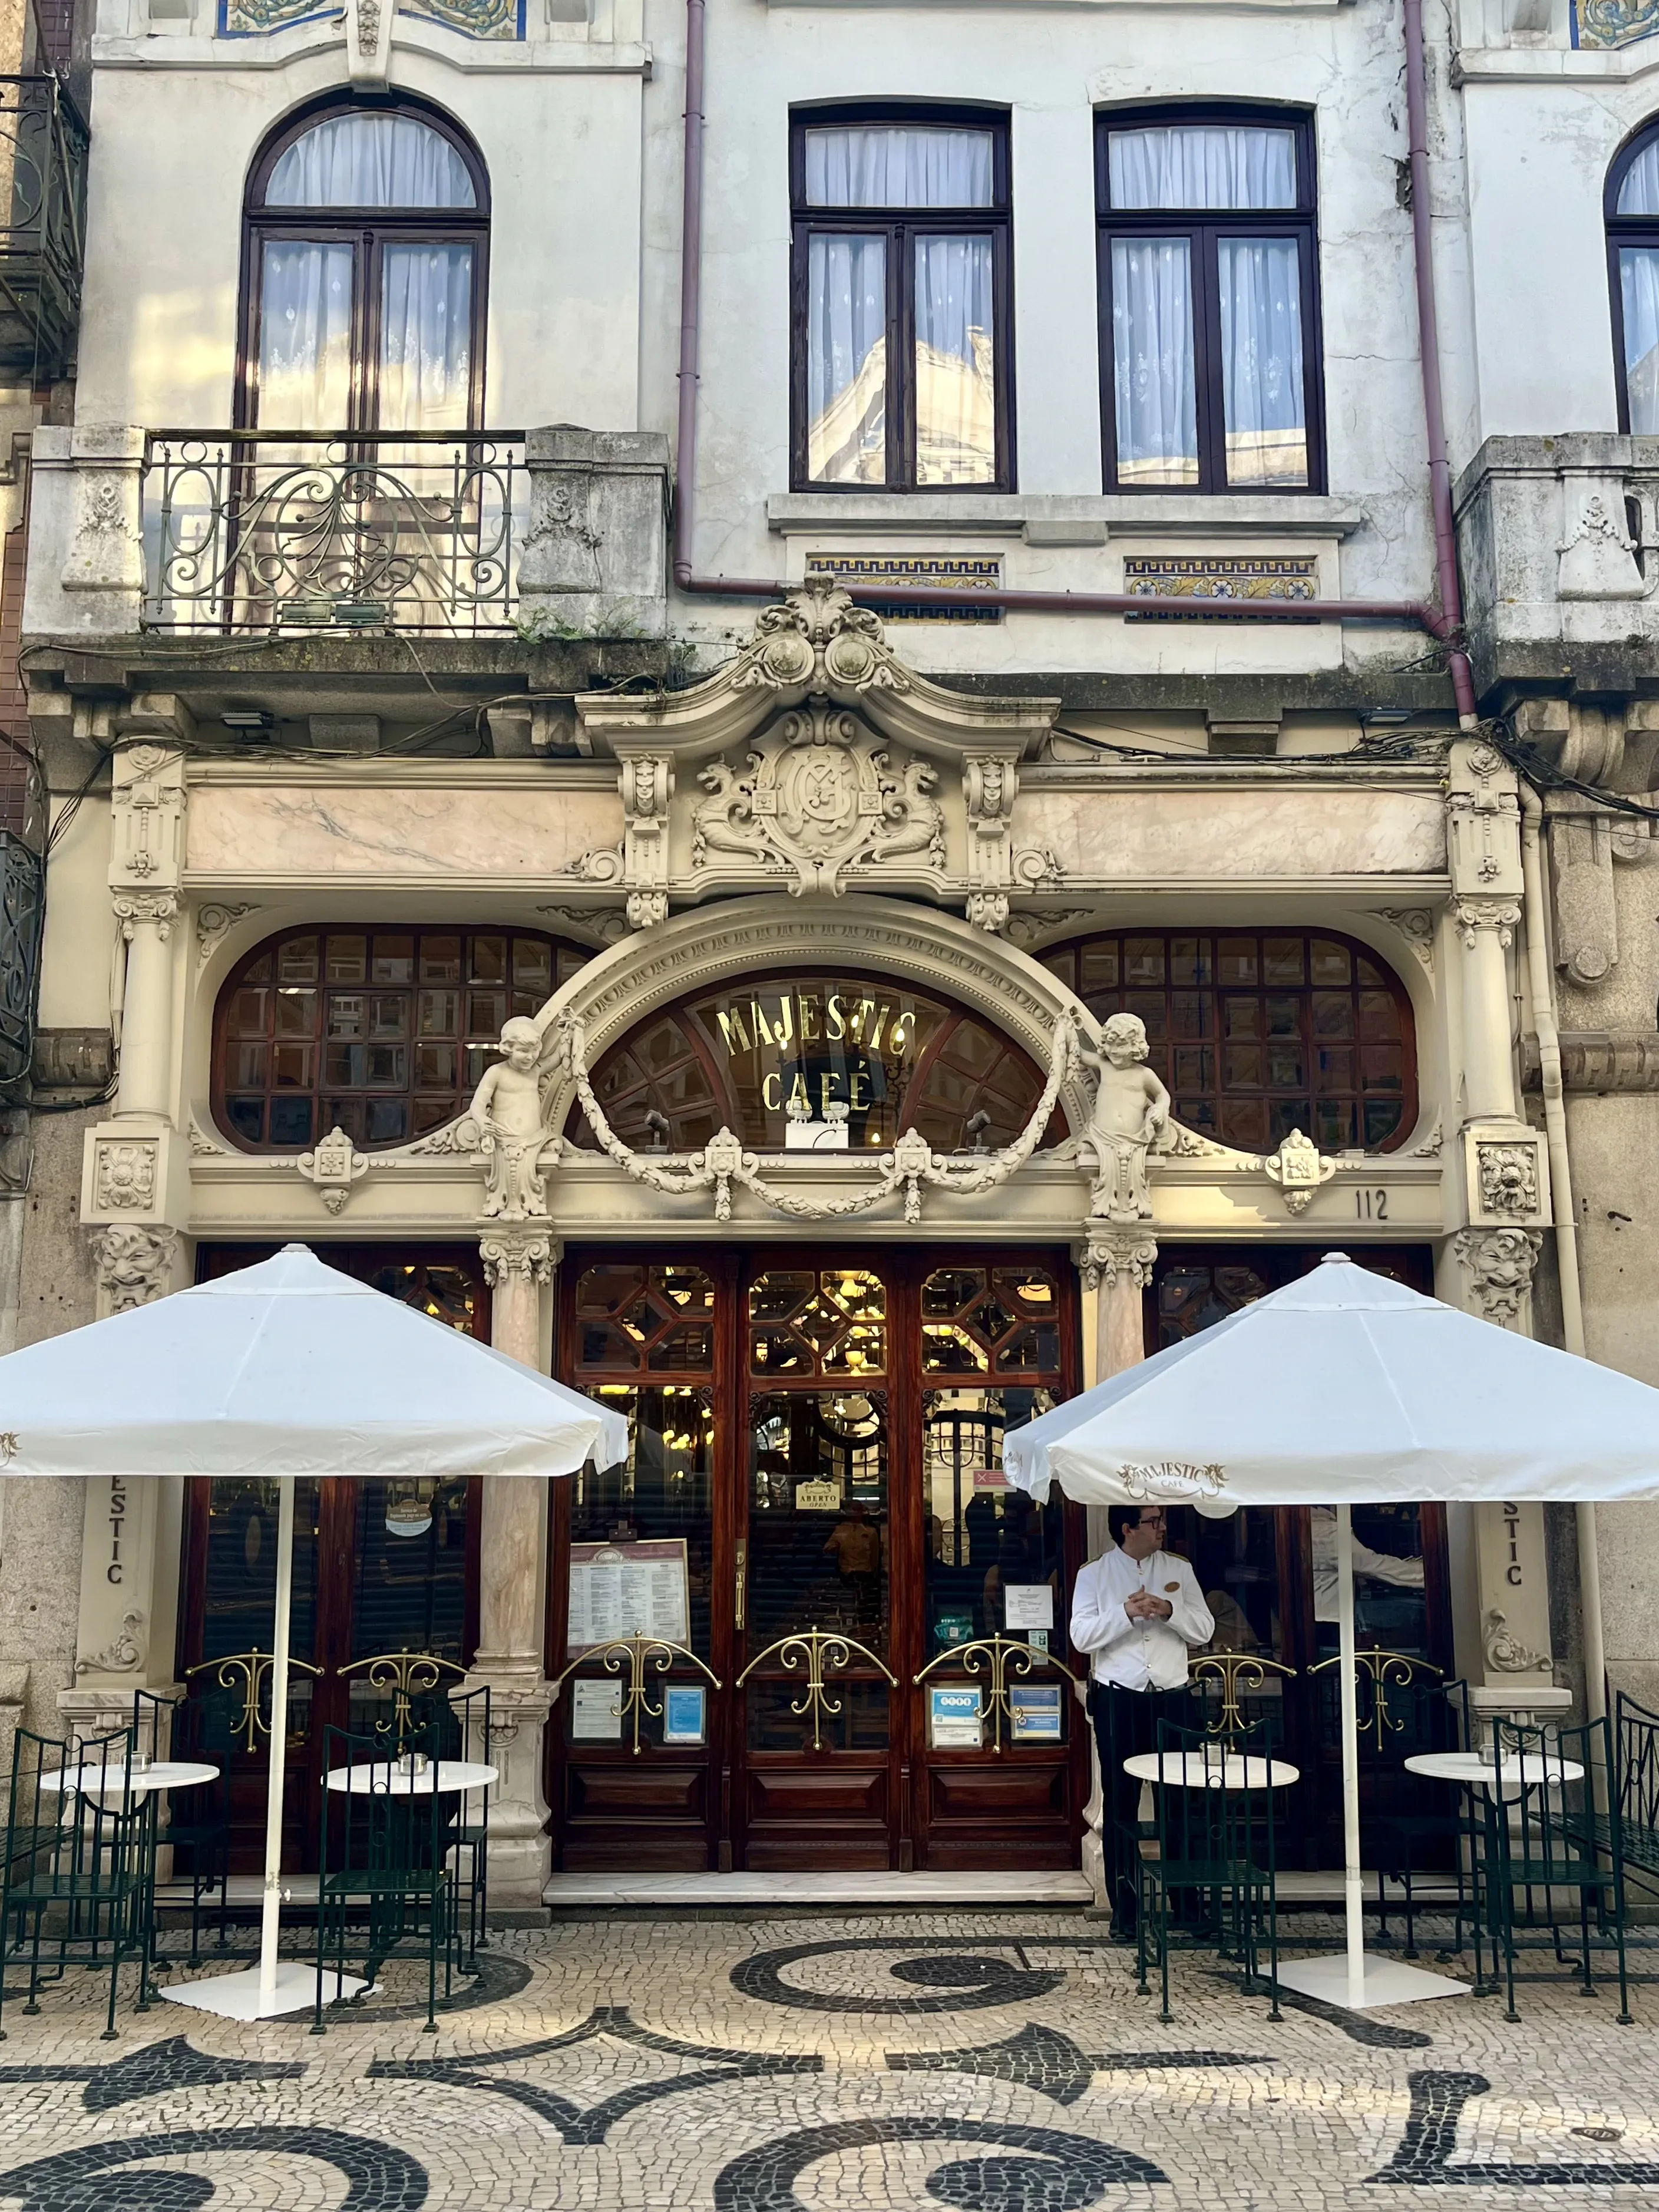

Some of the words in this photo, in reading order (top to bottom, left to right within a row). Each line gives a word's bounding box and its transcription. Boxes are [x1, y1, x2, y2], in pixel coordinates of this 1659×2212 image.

[716, 995, 916, 1057] MAJESTIC
[762, 1061, 871, 1111] CAFÉ
[1356, 1189, 1388, 1220] 112
[1139, 1462, 1204, 1483] MAJESTIC
